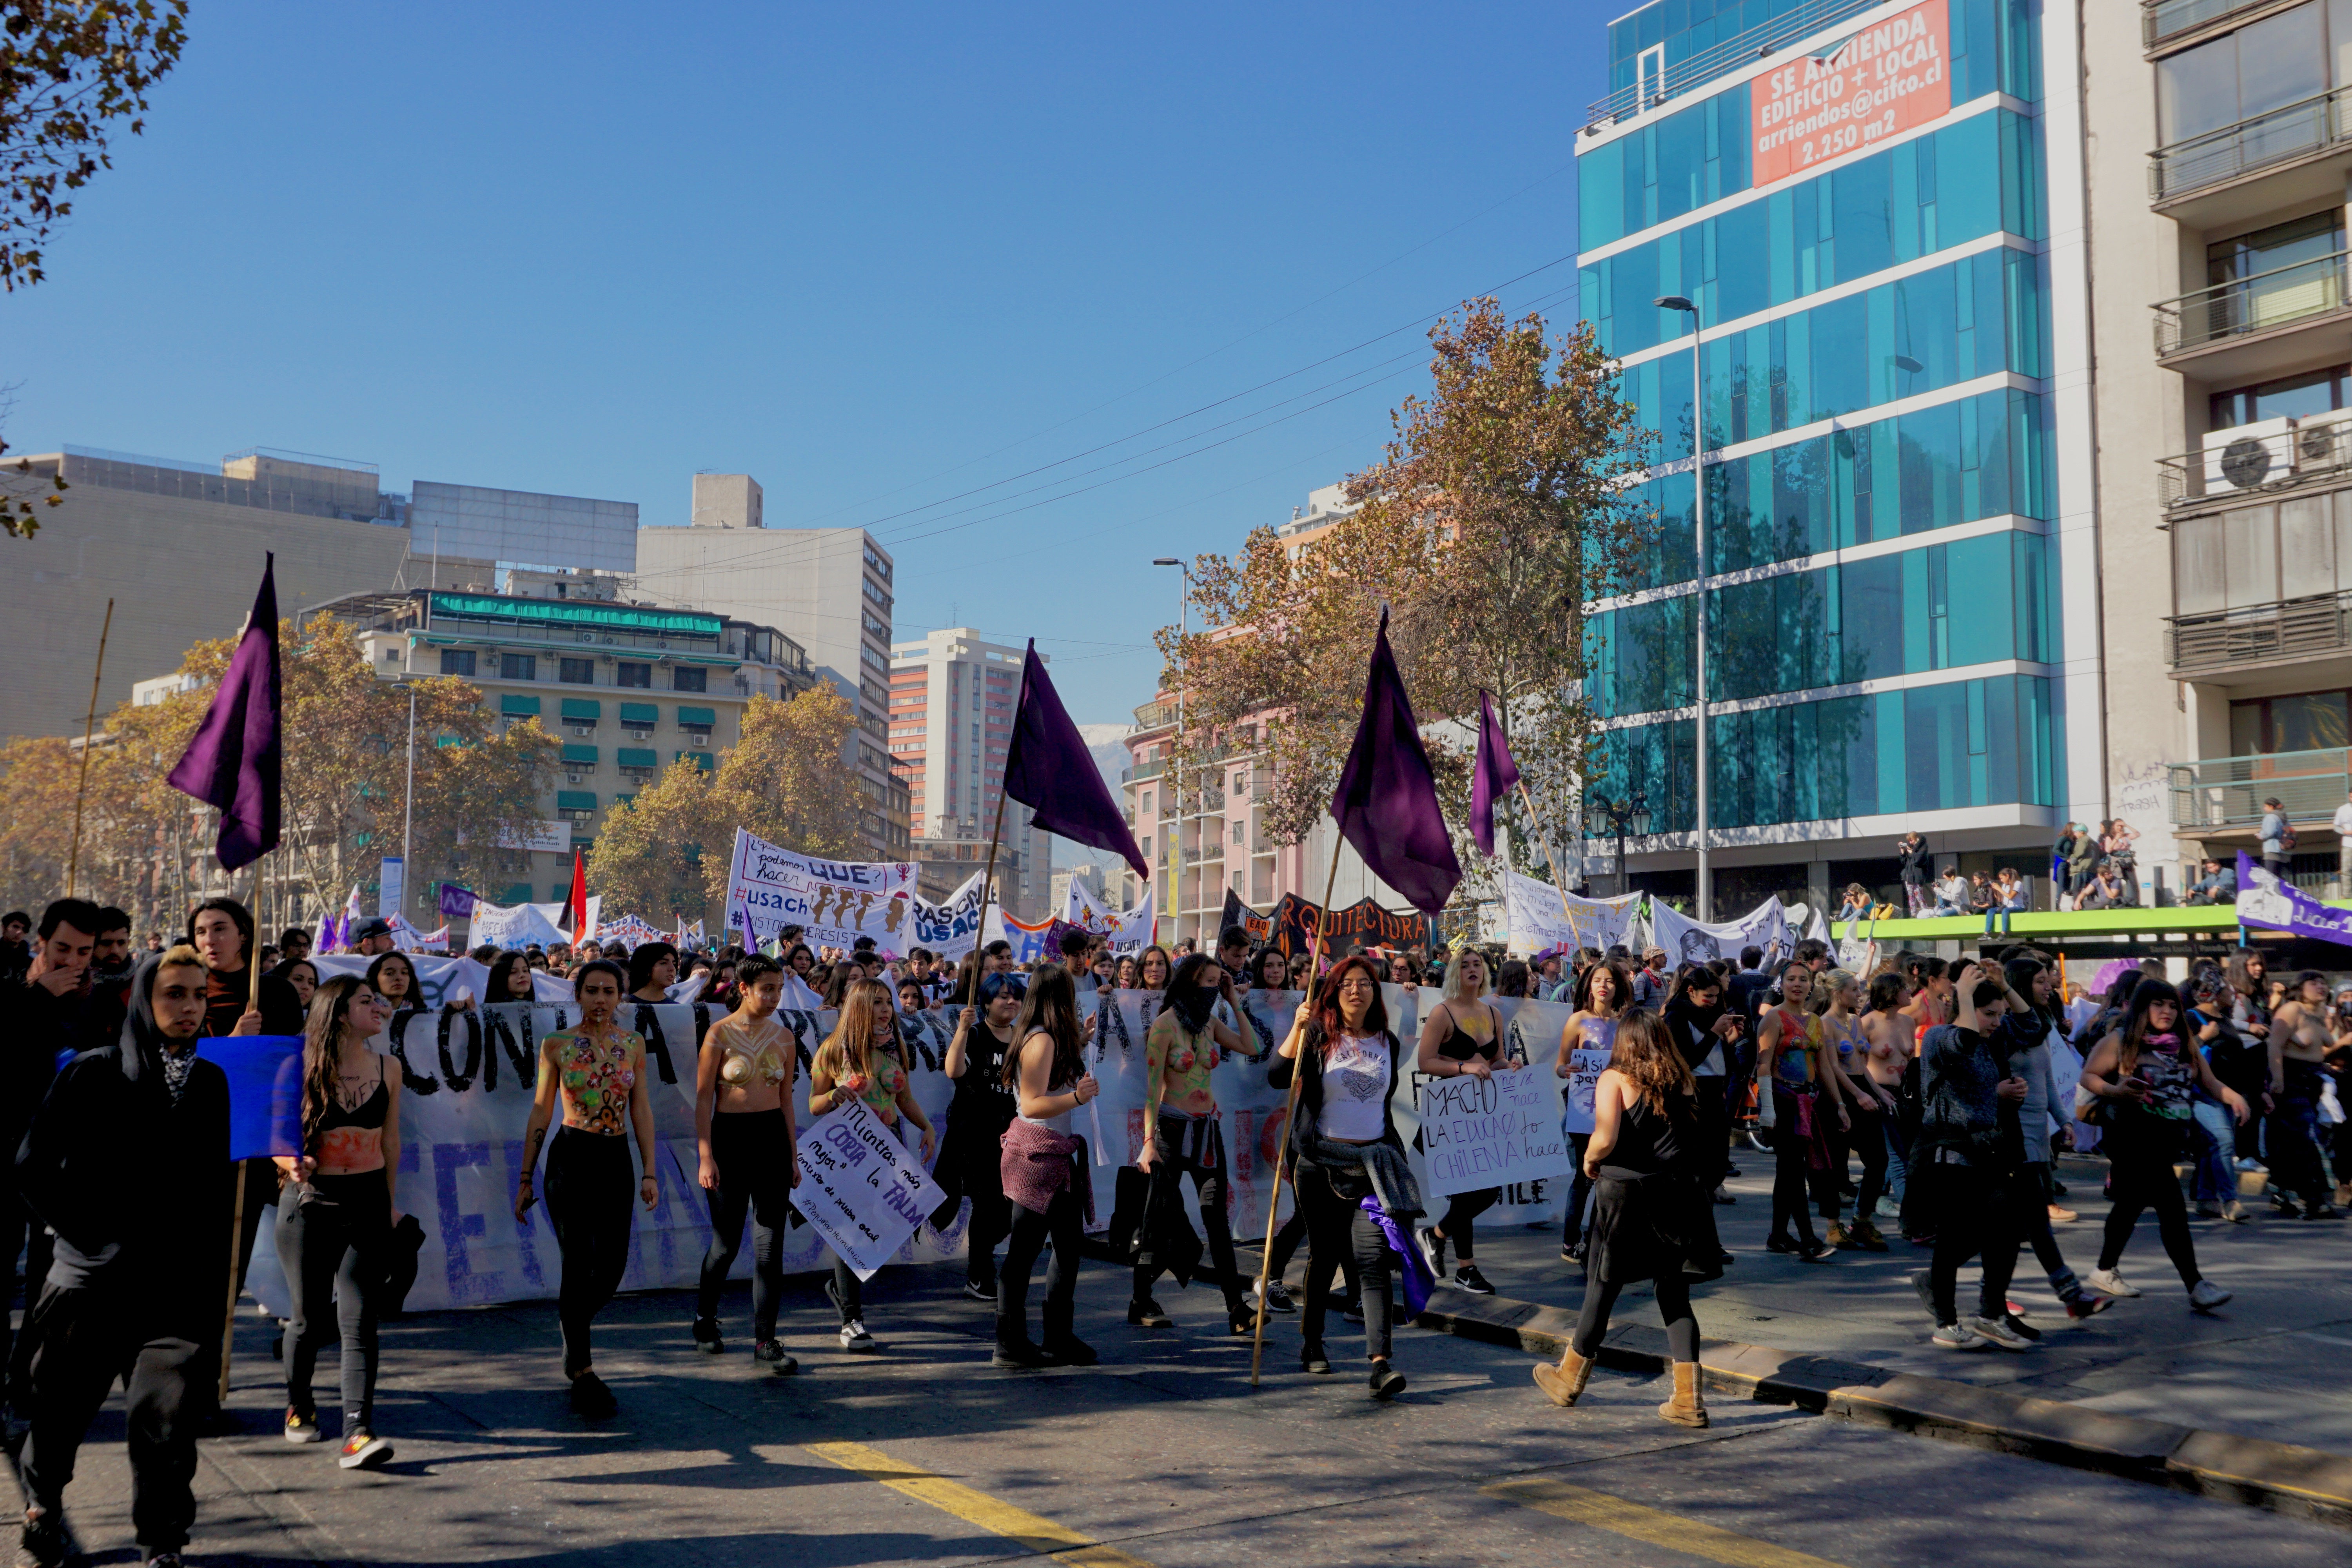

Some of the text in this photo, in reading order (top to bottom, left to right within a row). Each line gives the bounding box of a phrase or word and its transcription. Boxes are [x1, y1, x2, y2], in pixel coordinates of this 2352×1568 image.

[1761, 74, 1844, 128] EDIFICIO
[1876, 34, 1939, 81] LOCAL
[1770, 65, 1797, 100] SE
[1759, 56, 1942, 152] arriendos@cifco.cl
[1802, 109, 1896, 165] 2.250 m2
[734, 886, 808, 915] #usach
[1279, 897, 1425, 942] ARQUITECTURA
[915, 905, 984, 943] USAC
[1335, 1049, 1387, 1066] CALIFORNIA
[1427, 1076, 1498, 1117] MACHO
[842, 1099, 897, 1167] Mientras
[1426, 1123, 1450, 1148] LA
[825, 1123, 926, 1229] CORTA la FALDA
